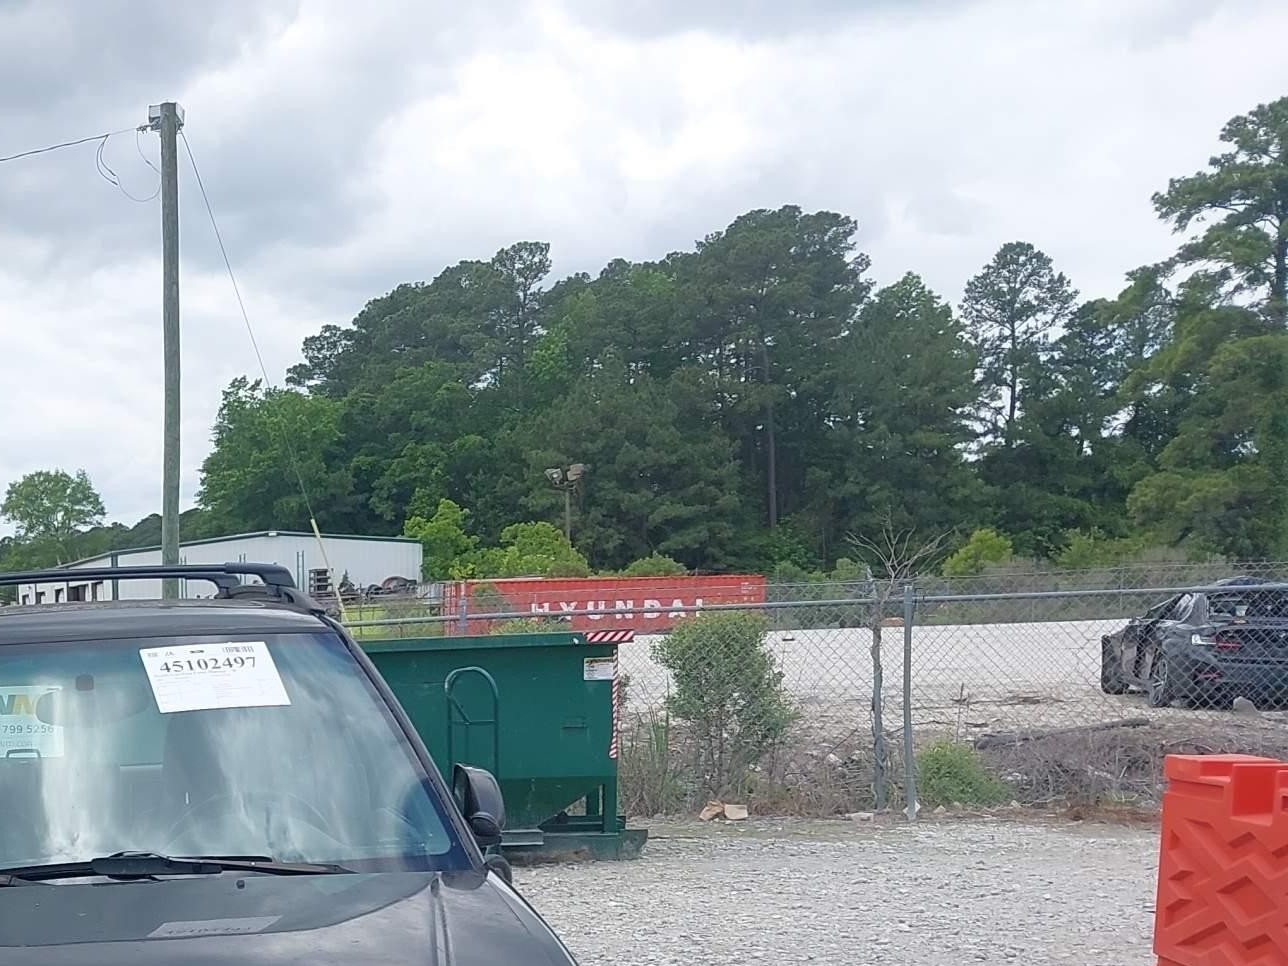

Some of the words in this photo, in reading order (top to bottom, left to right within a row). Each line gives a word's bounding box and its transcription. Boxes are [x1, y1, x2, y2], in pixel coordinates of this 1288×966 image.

[530, 598, 704, 621] HYUNDAI
[160, 656, 256, 673] 45102497
[2, 725, 23, 734] 799
[26, 724, 55, 734] 5256
